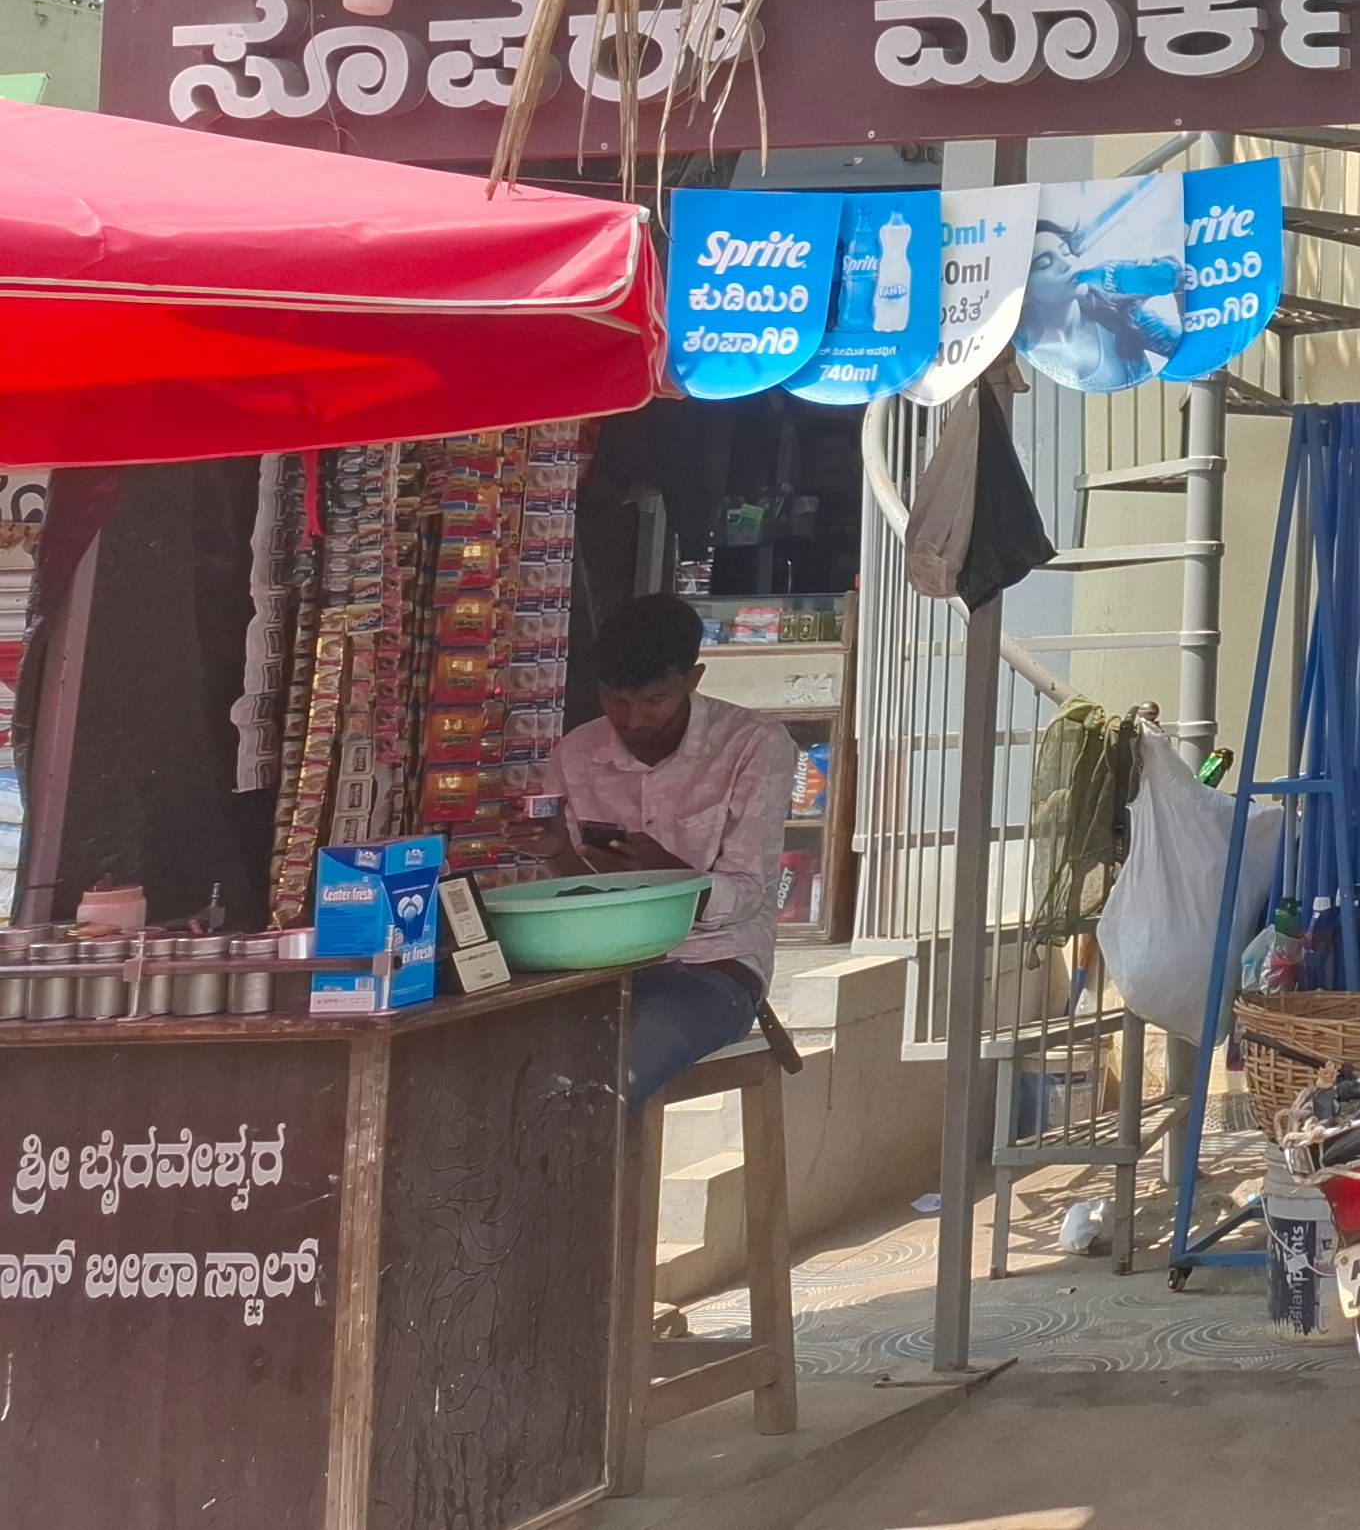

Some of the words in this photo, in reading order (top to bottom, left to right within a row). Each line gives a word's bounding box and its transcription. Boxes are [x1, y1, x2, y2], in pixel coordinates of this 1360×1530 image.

[941, 218, 985, 247] 0ml
[993, 221, 1006, 237] +
[1184, 205, 1255, 246] rite
[697, 230, 811, 275] Sprite
[941, 256, 990, 286] 0ml
[1184, 251, 1262, 291] ಡಿಯಿರಿ
[689, 282, 809, 313] ಕುಡಿಯಿರಿ
[1184, 293, 1259, 332] ಪಾಗಿರಿ
[683, 325, 799, 355] ತಂಪಾಗಿರಿ
[820, 364, 878, 382] 740ml
[323, 887, 351, 902] Center
[352, 887, 374, 902] fresh
[12, 1134, 70, 1215] ಶ್ರೀ
